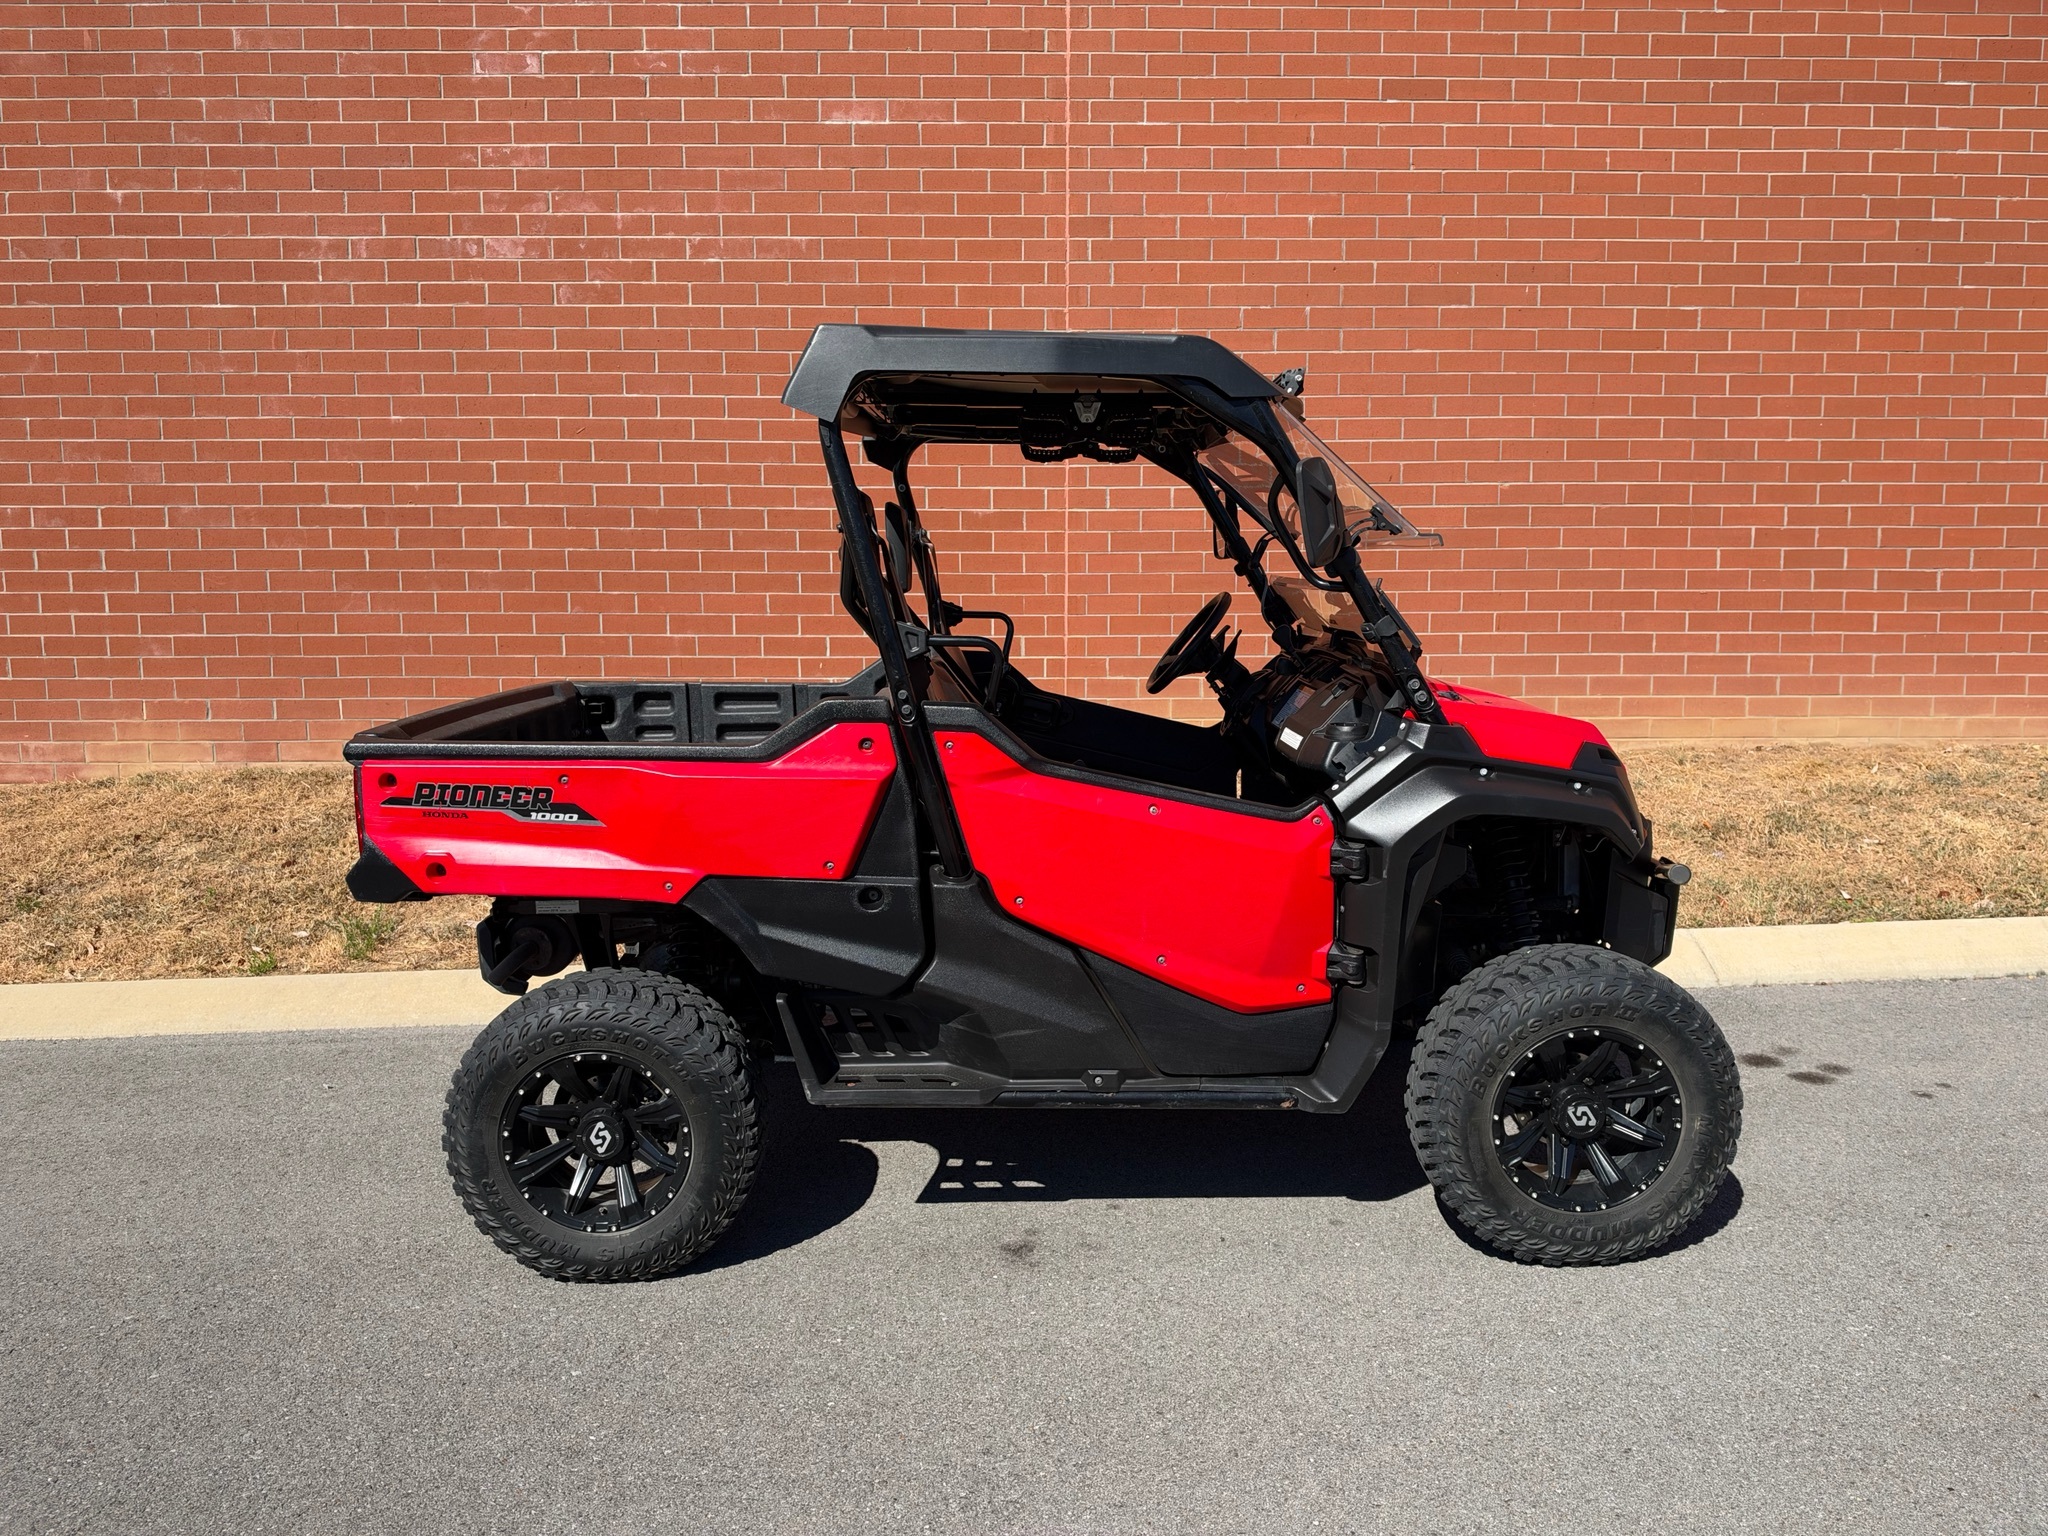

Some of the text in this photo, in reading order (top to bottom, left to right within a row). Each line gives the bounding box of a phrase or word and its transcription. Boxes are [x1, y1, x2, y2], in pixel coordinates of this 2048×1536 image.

[412, 782, 554, 810] PIONEER
[421, 811, 469, 819] HONDA
[529, 812, 579, 822] 1000
[509, 1027, 671, 1069] BUCKSHOT
[1468, 1002, 1608, 1100] BUCKSHOT
[481, 1178, 583, 1260] MUDDER
[1512, 1207, 1633, 1243] MUDDER
